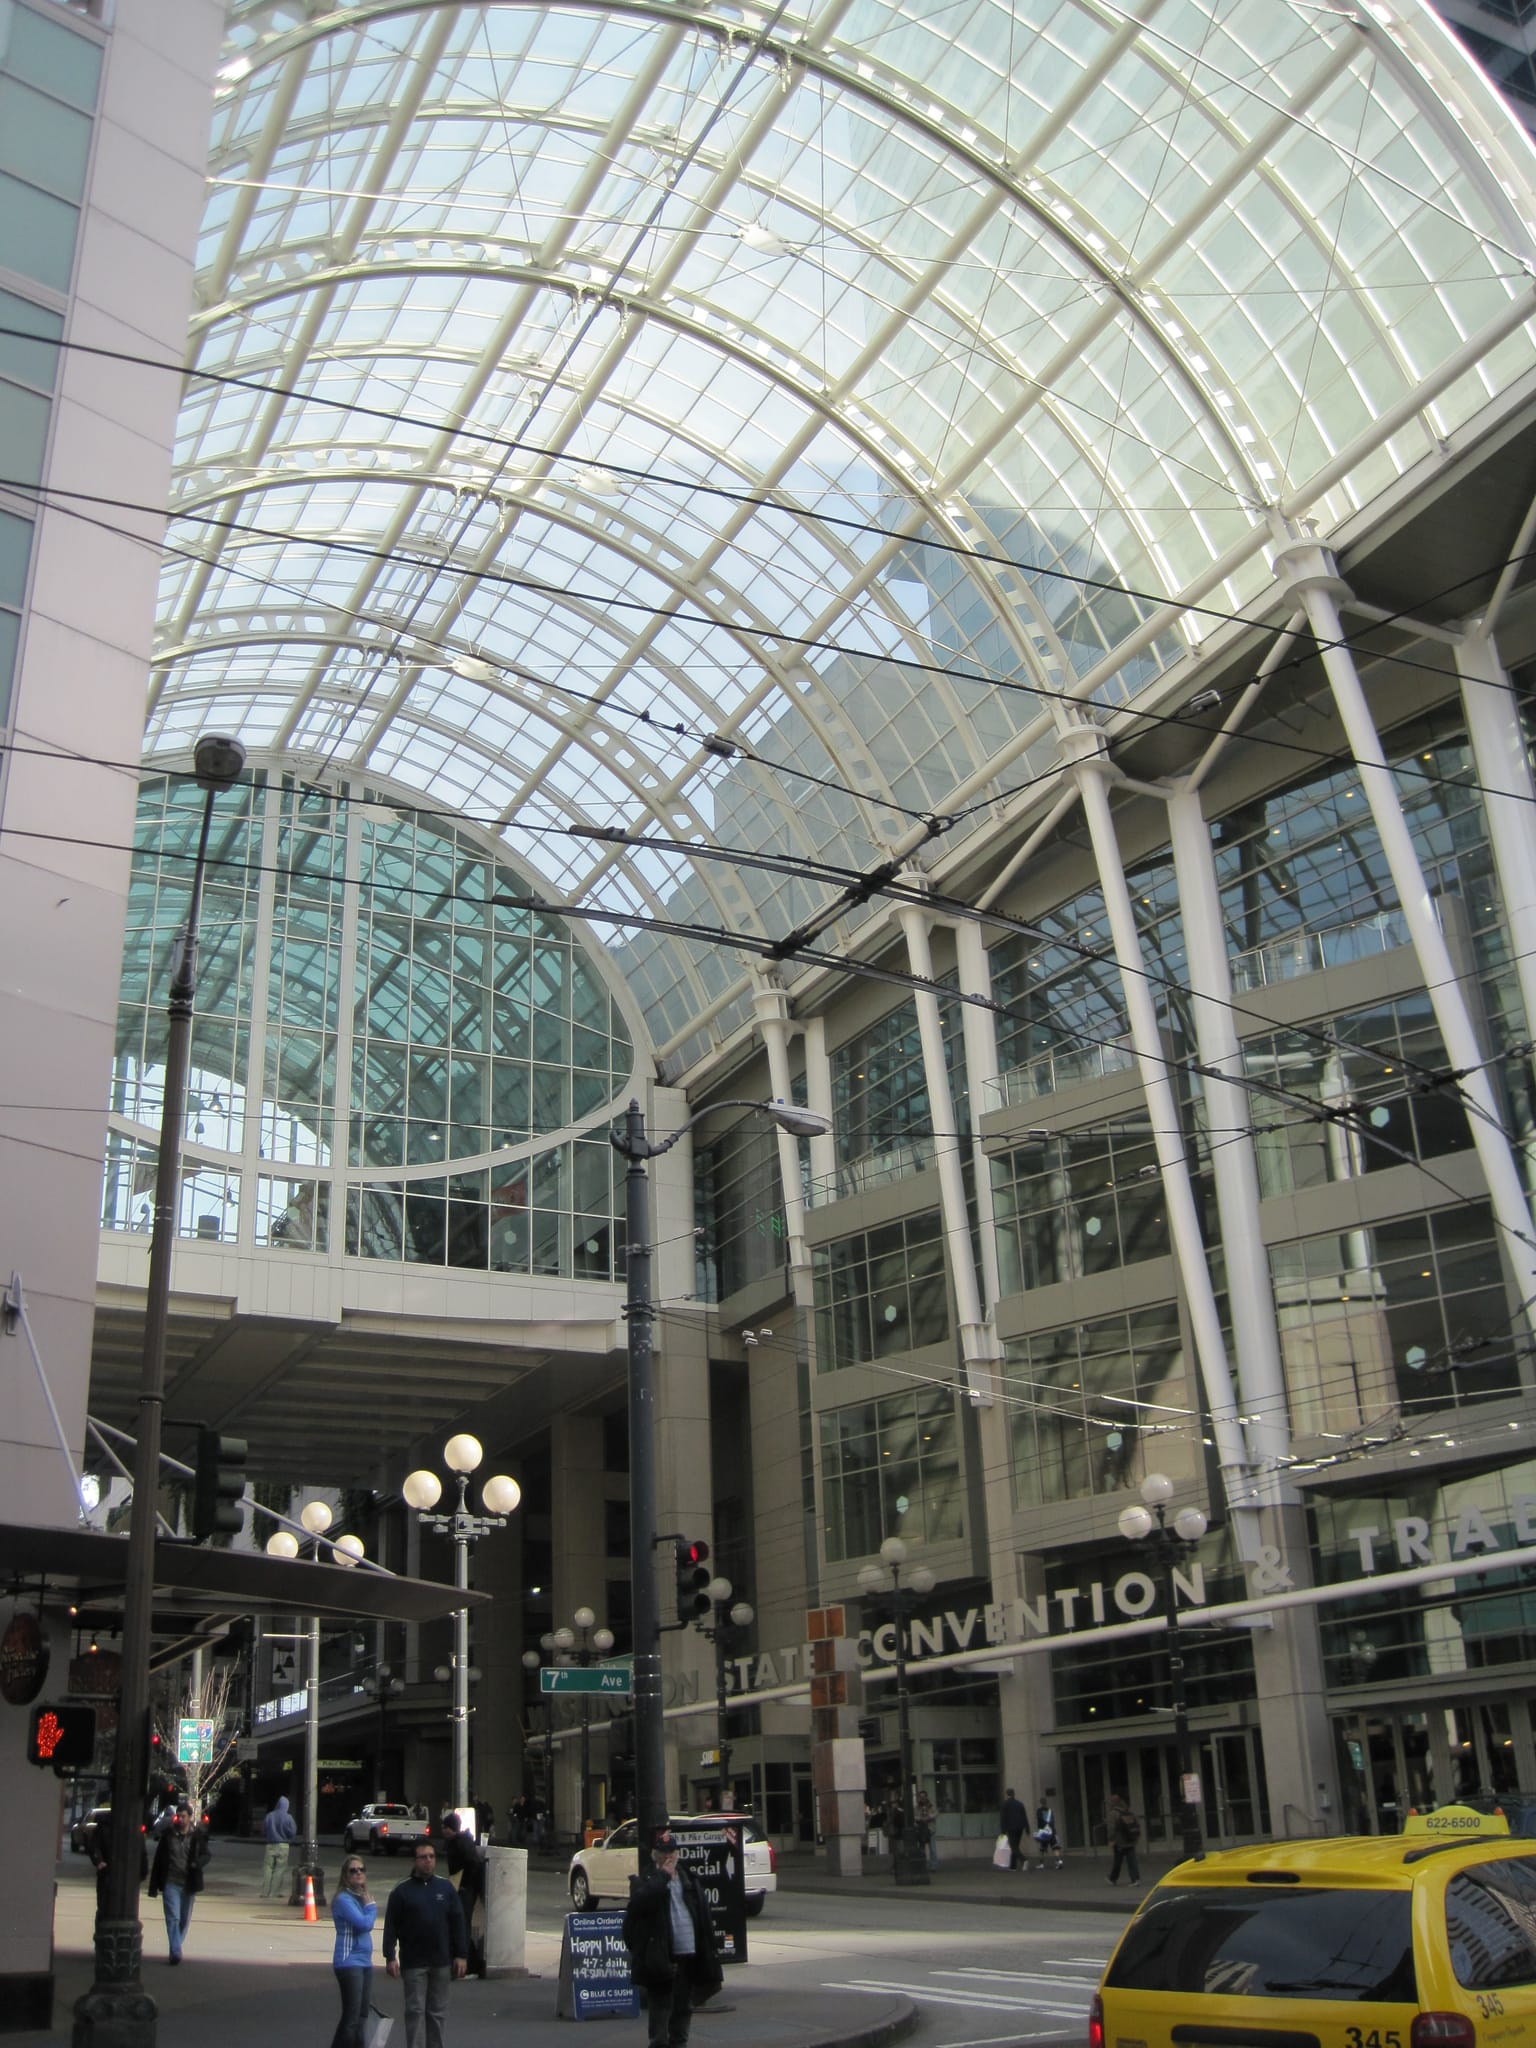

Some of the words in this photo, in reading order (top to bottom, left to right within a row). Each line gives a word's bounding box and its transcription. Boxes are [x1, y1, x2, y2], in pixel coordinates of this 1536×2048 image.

[1251, 1545, 1296, 1591] &
[546, 1671, 568, 1689] 7th
[601, 1674, 623, 1687] Ave
[1426, 1817, 1481, 1829] 622-6500
[679, 1845, 711, 1862] Daily
[573, 1917, 595, 1926] Online
[597, 1916, 623, 1925] Orderin
[570, 1936, 602, 1956] Happy
[605, 1935, 629, 1952] Hou
[605, 1957, 627, 1968] daily
[590, 1989, 606, 1998] BLUE
[607, 1989, 613, 1997] C
[614, 1988, 634, 1997] SUSHI
[1476, 1992, 1504, 2020] 345
[1345, 2026, 1402, 2048] 345
